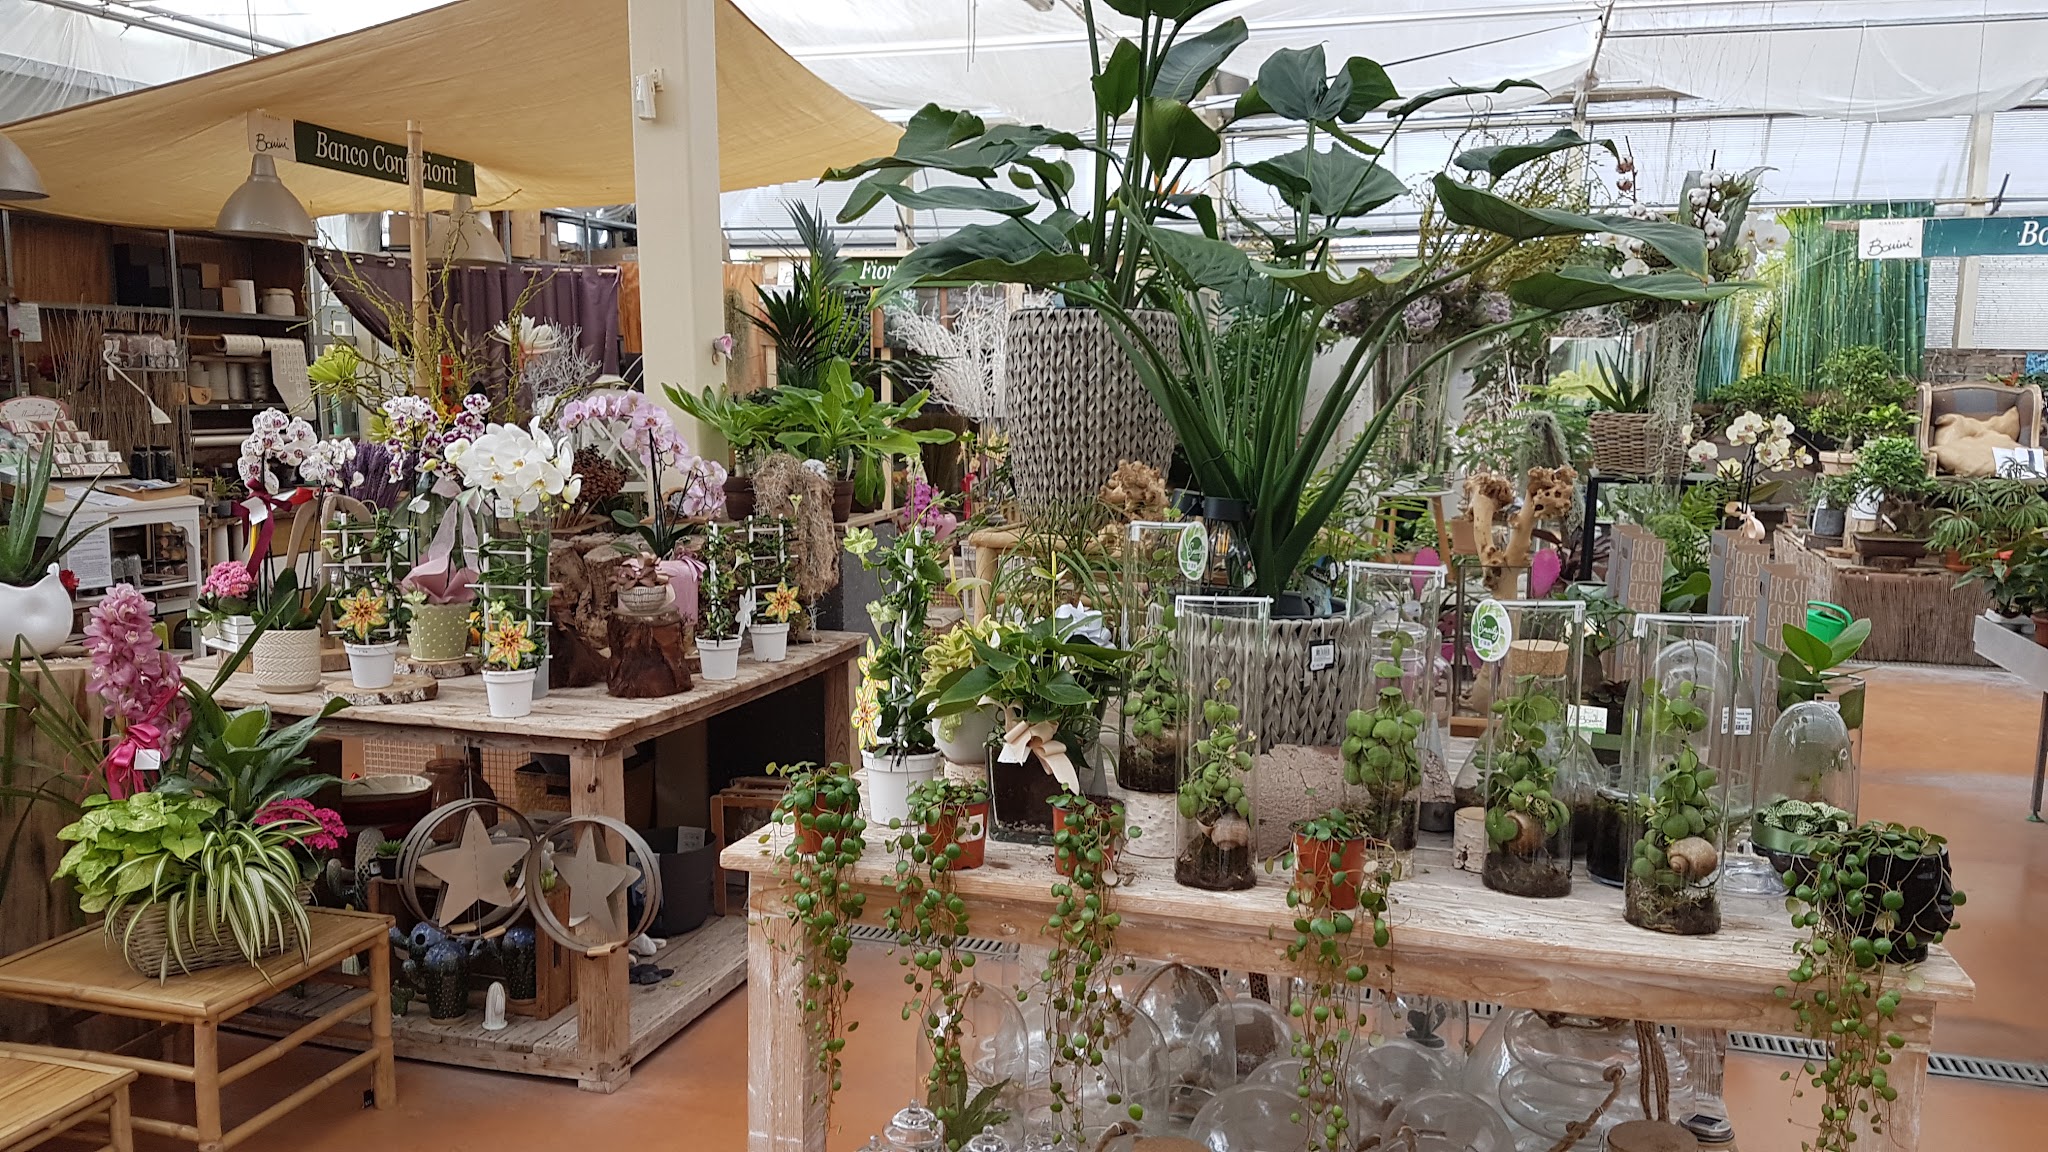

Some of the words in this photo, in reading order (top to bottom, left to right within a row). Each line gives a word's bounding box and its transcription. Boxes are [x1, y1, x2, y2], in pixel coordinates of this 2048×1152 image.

[315, 130, 369, 168] Banco
[372, 144, 458, 186] Confzioni
[859, 259, 896, 280] Fior
[1632, 538, 1666, 563] FRESH
[1629, 561, 1662, 583] GREEN
[1627, 582, 1660, 604] CLEAN
[1734, 576, 1759, 598] GREE
[1769, 575, 1809, 605] FRESH
